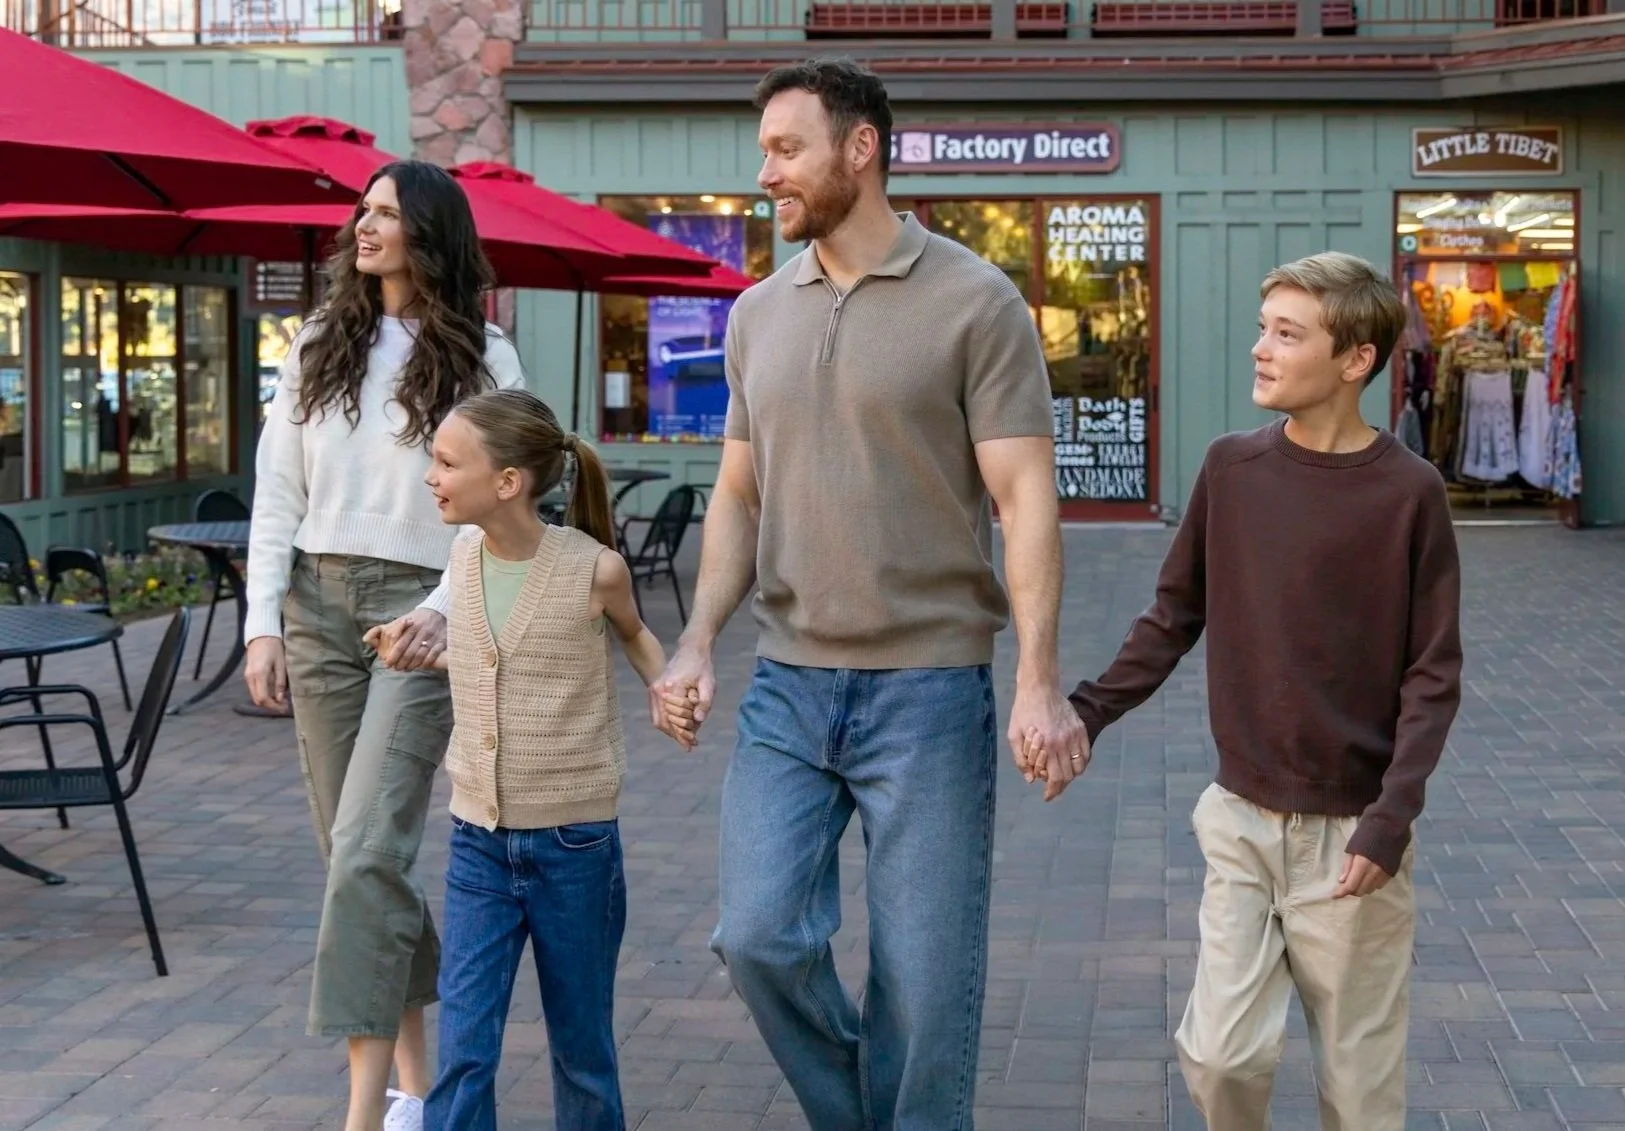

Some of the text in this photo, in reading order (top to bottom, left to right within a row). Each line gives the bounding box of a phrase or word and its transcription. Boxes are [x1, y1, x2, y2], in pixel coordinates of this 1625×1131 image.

[934, 133, 1027, 165] Factory
[1033, 130, 1111, 159] Direct
[1417, 132, 1559, 167] LITTLE TIBET
[1047, 205, 1145, 226] AROMA
[1048, 226, 1145, 243] HEALING
[1047, 244, 1145, 262] CENTER
[1128, 397, 1145, 443] GIFTS
[1077, 431, 1127, 443] Products
